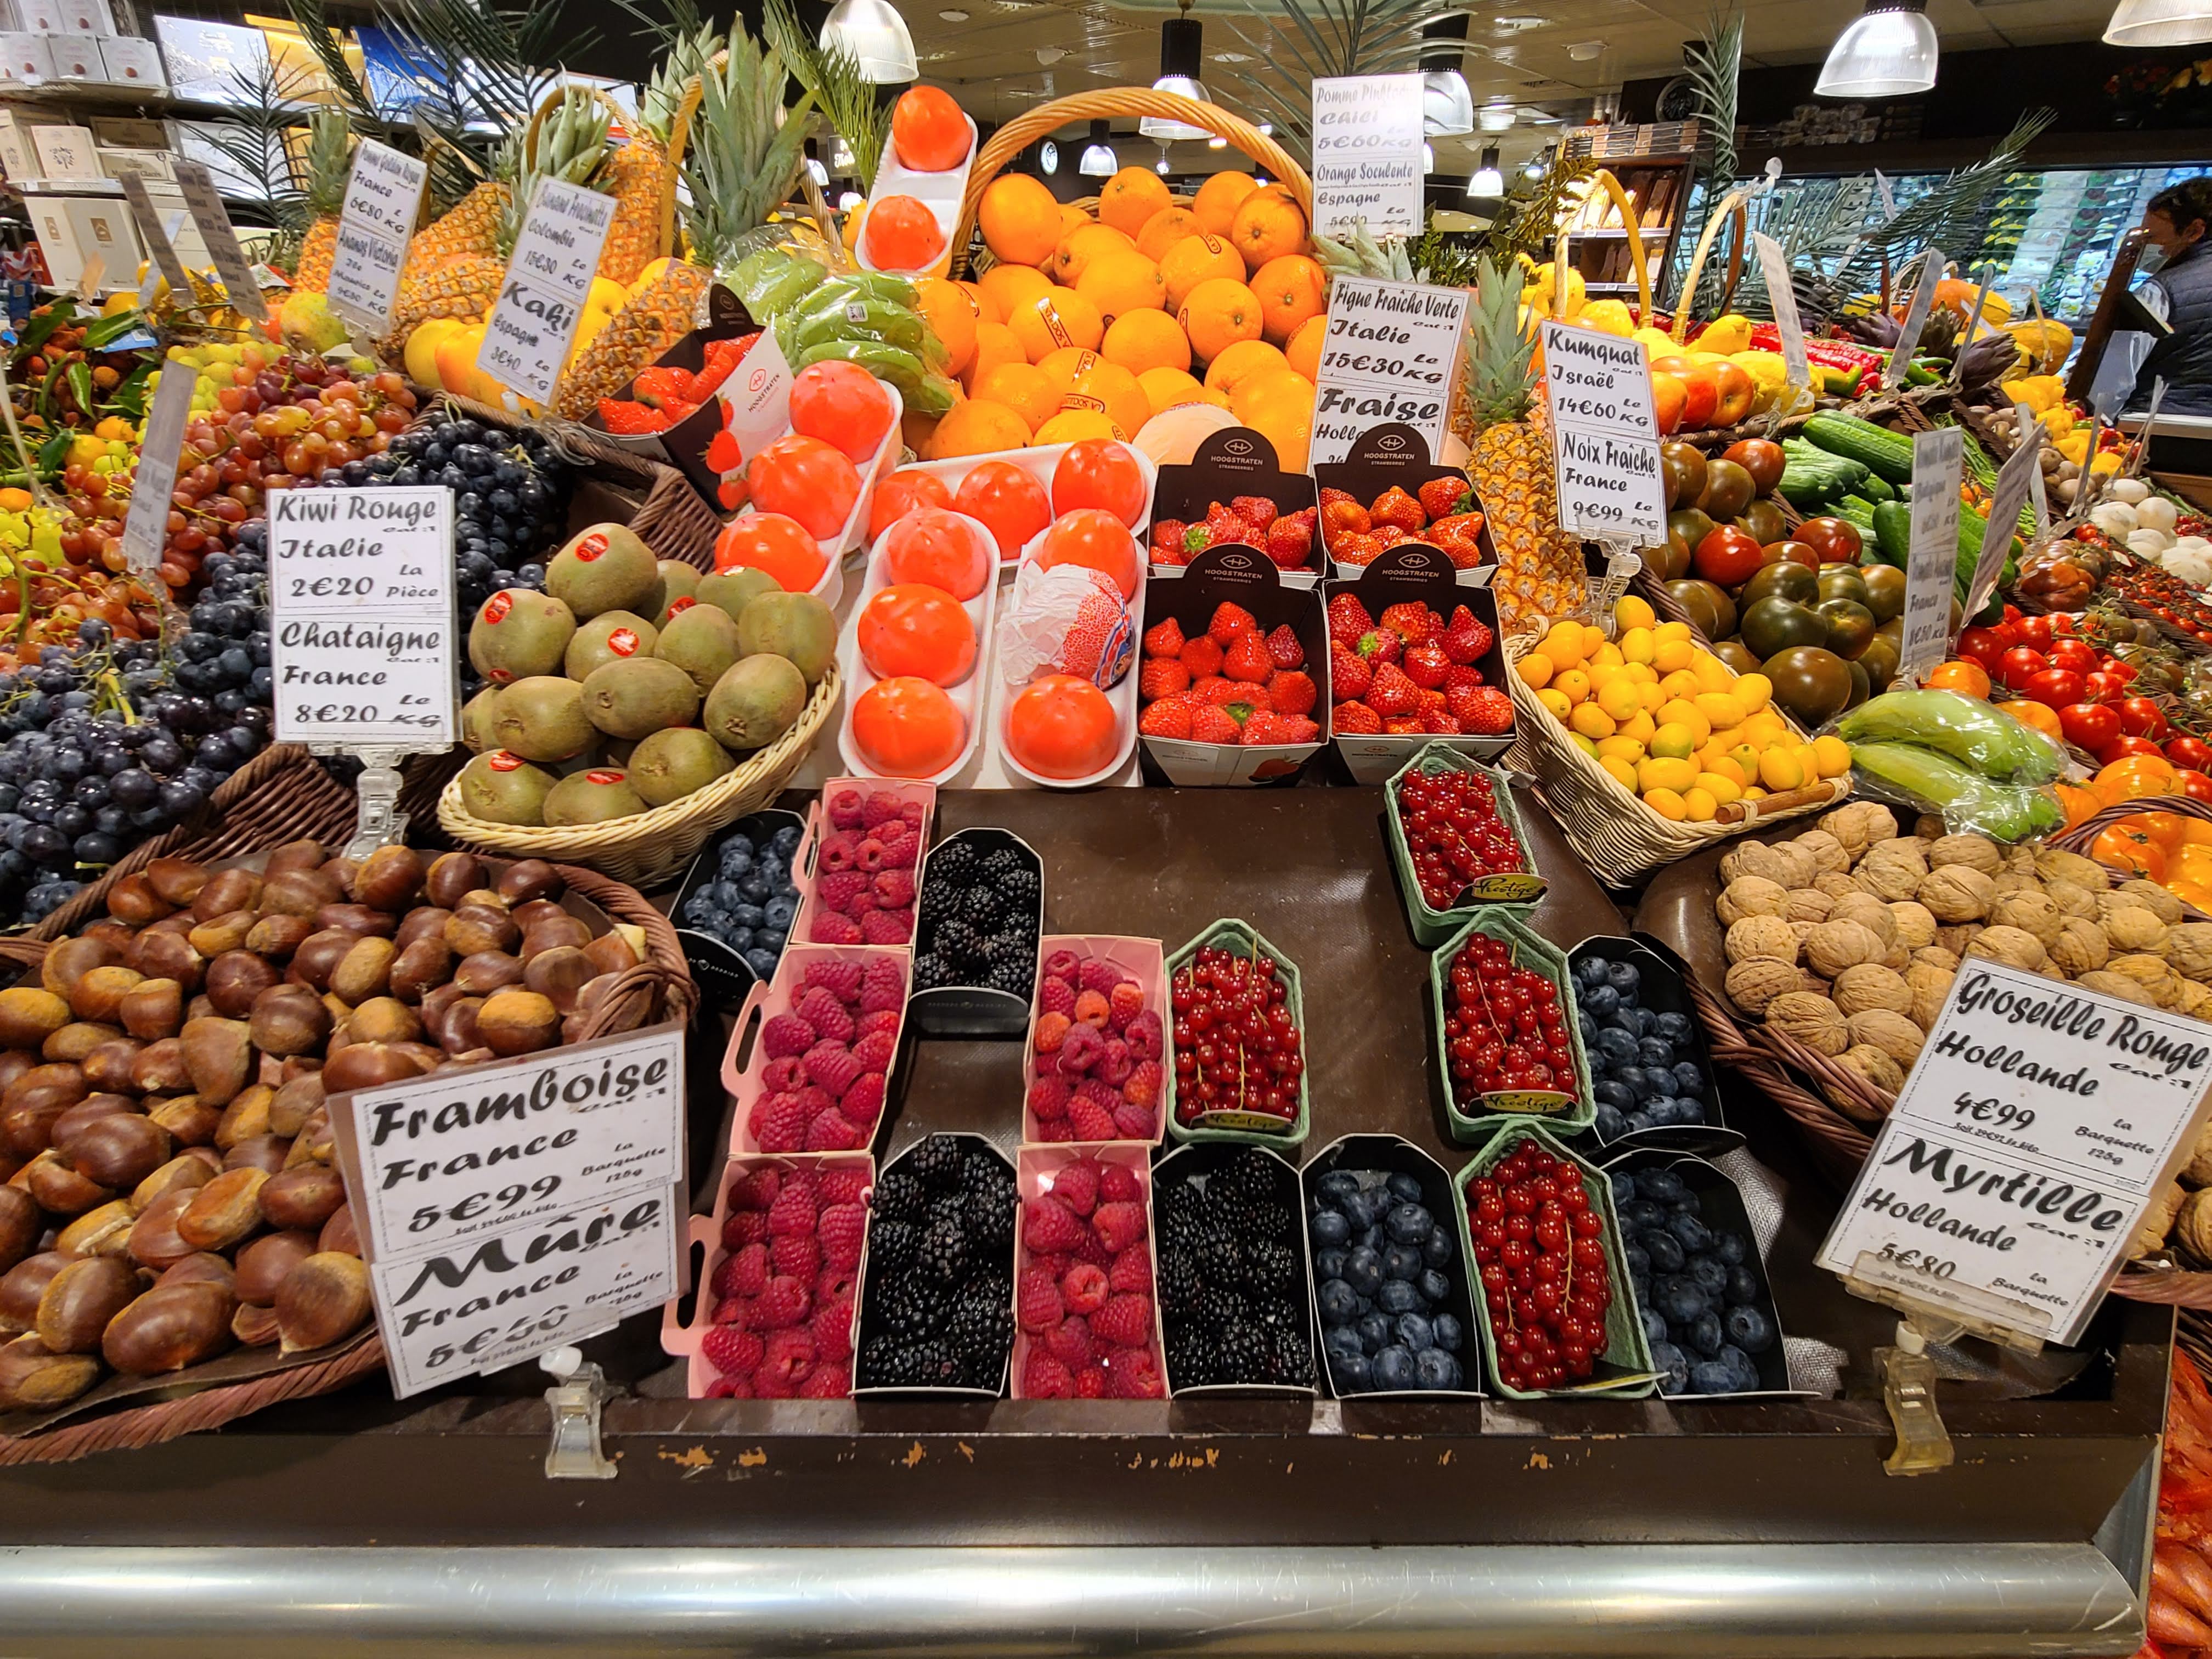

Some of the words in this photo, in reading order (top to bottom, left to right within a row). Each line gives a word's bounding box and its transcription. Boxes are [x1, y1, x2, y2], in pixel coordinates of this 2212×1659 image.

[1317, 164, 1356, 184] Orange
[1318, 192, 1380, 207] Espagne
[563, 273, 586, 290] KG
[503, 281, 575, 332] Kaki
[1334, 283, 1372, 313] Figue
[1425, 294, 1459, 320] Verte
[1330, 319, 1411, 345] Italie
[1413, 354, 1439, 364] Le
[1548, 328, 1640, 366] Kumquat
[1324, 352, 1404, 375] 15€30
[1402, 369, 1444, 384] KG
[1551, 364, 1615, 390] Israël
[1318, 388, 1440, 421] Fraise
[1557, 396, 1616, 420] 14€60
[1619, 413, 1649, 427] KG
[1623, 398, 1641, 409] Le
[1211, 455, 1263, 465] HOOGSTRATEN
[1562, 432, 1601, 466] Noix
[1606, 441, 1656, 475] Fraîche
[1565, 467, 1628, 492] France
[276, 495, 337, 523] Kiwi
[347, 495, 437, 526] Rouge
[1572, 500, 1623, 522] 9€99
[1634, 500, 1653, 512] Le
[279, 538, 383, 559] Italie
[399, 564, 423, 576] La
[1205, 568, 1262, 580] HOOGSTRATEN
[1382, 569, 1440, 578] HOOGSTRATEN
[291, 576, 374, 597] 2€20
[386, 586, 439, 598] Pièce
[280, 622, 441, 656] Chataigne
[283, 665, 388, 686] France
[399, 694, 431, 705] Le
[295, 704, 377, 723] 8€20
[390, 714, 442, 727] KG
[1472, 877, 1537, 899] Prestige
[1957, 973, 2106, 1041] Groseille
[2107, 1015, 2210, 1071] Rouge
[1935, 1030, 2099, 1096] Hollande
[2109, 1061, 2164, 1081] Cat
[371, 1057, 668, 1146] Framboise
[1953, 1091, 2036, 1131] 4€99
[2113, 1118, 2132, 1131] La
[614, 1141, 634, 1152] La
[2074, 1125, 2155, 1155] Barquette
[381, 1128, 579, 1190] France
[582, 1146, 666, 1177] Barquette
[2087, 1147, 2124, 1166] 125g
[1882, 1138, 2124, 1232] Myrtille
[408, 1175, 563, 1233] 5€99
[1861, 1187, 2018, 1252] Hollande
[2027, 1221, 2080, 1242] Cat
[394, 1199, 661, 1307] Mûre
[1876, 1242, 1956, 1281] 5€80
[613, 1269, 633, 1280] La
[2029, 1272, 2049, 1284] La
[401, 1265, 580, 1338] France
[584, 1272, 664, 1305] Barquette
[1992, 1277, 2070, 1308] Barquette
